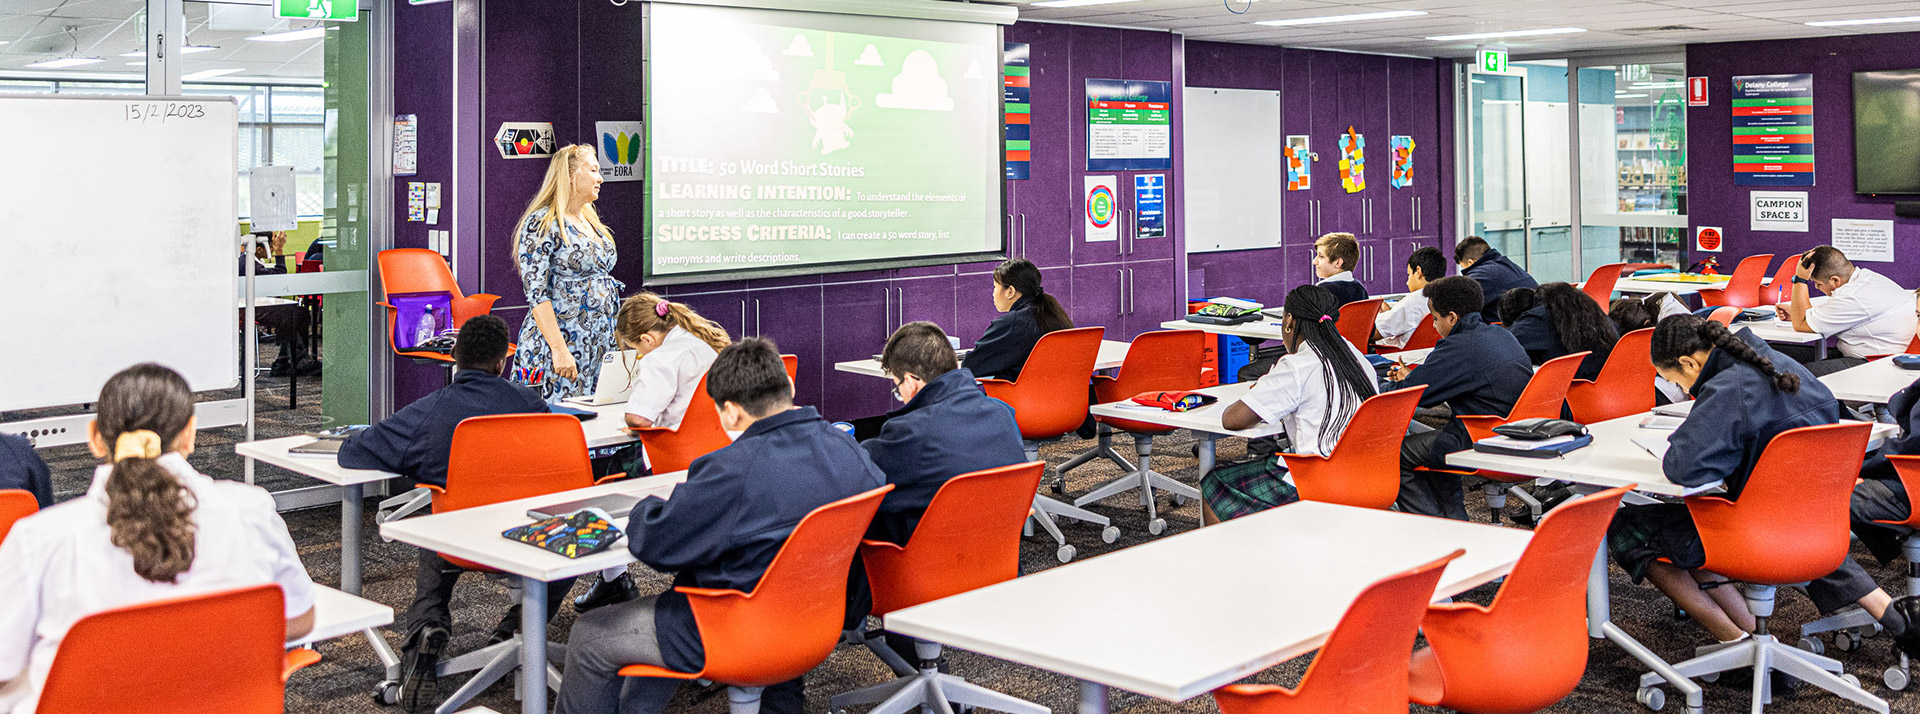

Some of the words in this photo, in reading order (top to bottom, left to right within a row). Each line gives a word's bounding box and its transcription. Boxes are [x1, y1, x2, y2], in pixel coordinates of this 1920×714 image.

[126, 103, 205, 124] 15/2/2023
[614, 166, 633, 176] EORA
[658, 156, 714, 173] TITLE:
[719, 162, 736, 176] 50
[741, 160, 778, 175] Word
[781, 160, 818, 176] Short
[820, 162, 864, 178] Stories
[659, 182, 751, 200] LEARNING
[757, 185, 851, 201] INTENTION:
[856, 192, 865, 201] To
[867, 192, 911, 201] understand
[912, 192, 924, 201] the
[925, 192, 958, 202] elements
[959, 193, 966, 202] of
[1757, 200, 1802, 208] CAMPION
[666, 208, 691, 218] short
[692, 210, 714, 220] story
[726, 208, 743, 218] well
[756, 208, 771, 218] the
[772, 208, 831, 218] characteristics
[832, 208, 840, 217] of
[848, 208, 867, 219] good
[1760, 211, 1790, 219] SPACE
[658, 224, 742, 242] SUCCESS
[747, 224, 831, 242] CRITERIA:
[888, 232, 897, 240] 50
[899, 230, 917, 239] word
[918, 230, 938, 241] story,
[939, 230, 950, 239] list
[657, 254, 703, 266] synonyms
[705, 253, 721, 263] and
[723, 253, 746, 263] write
[748, 252, 800, 264] descriptions.
